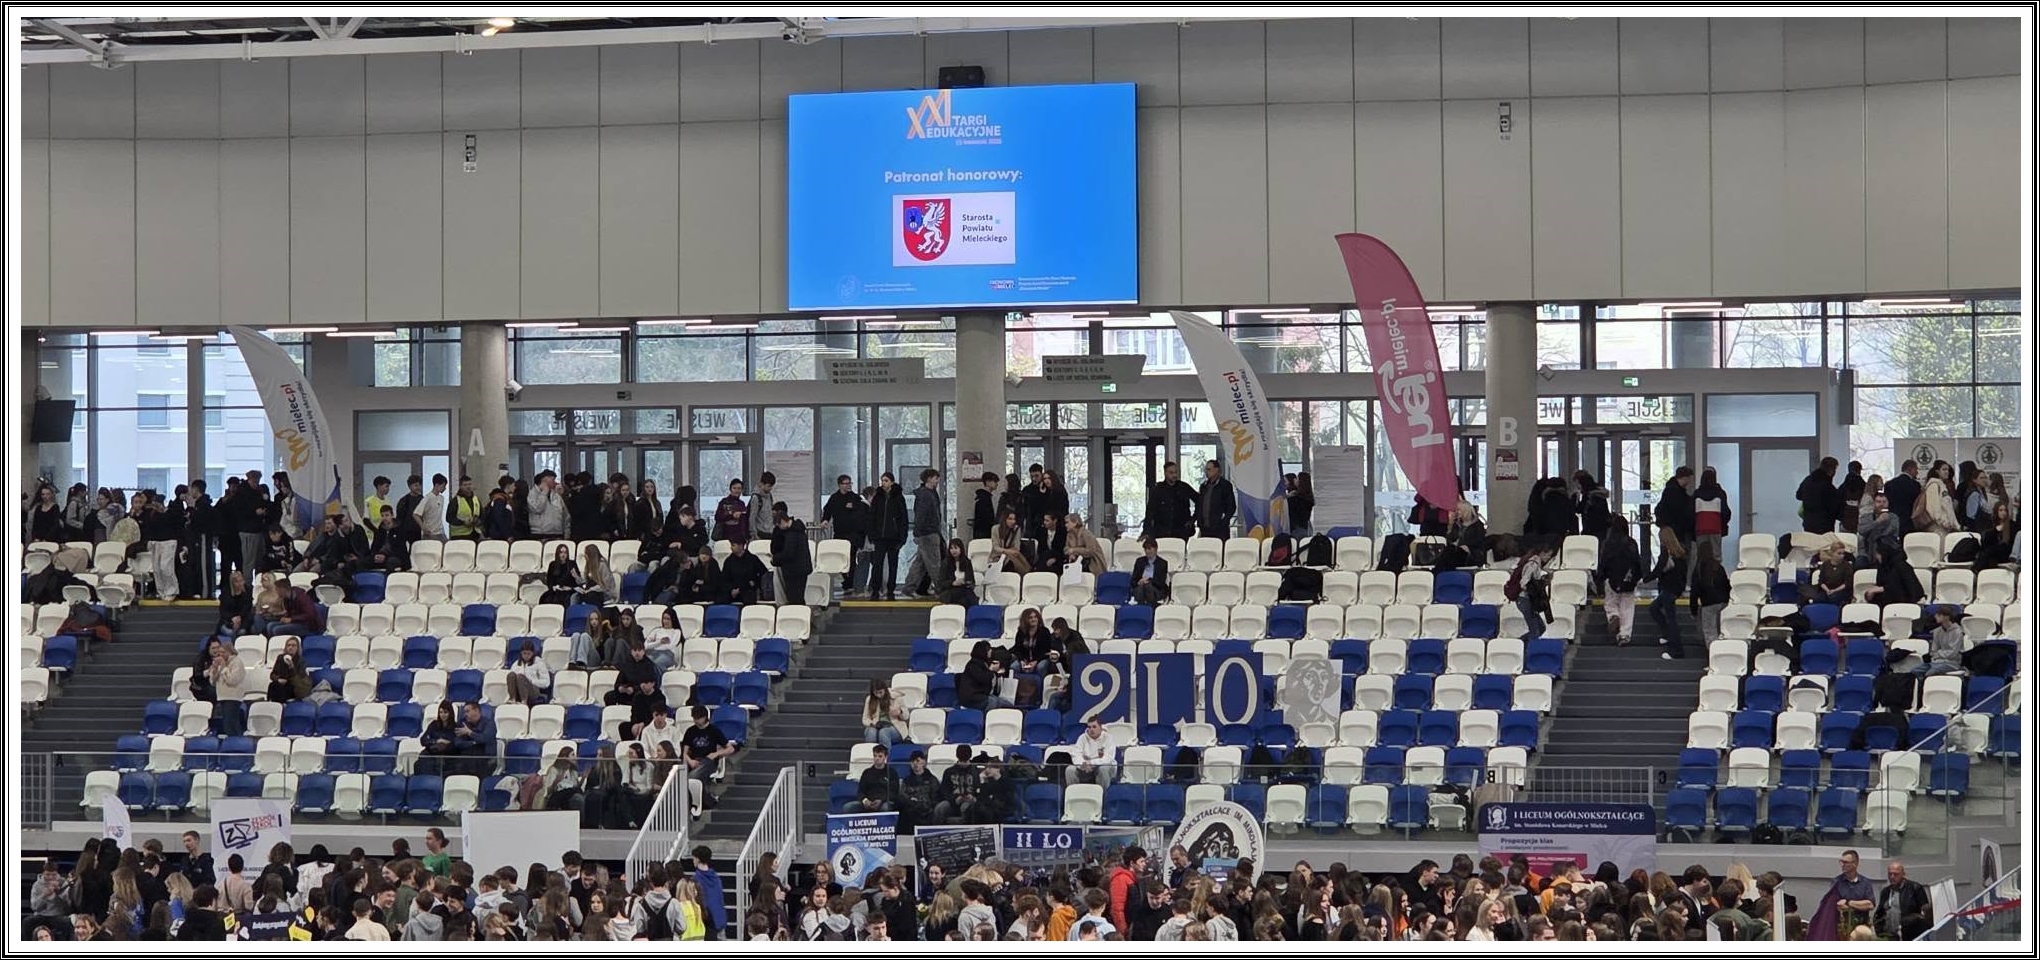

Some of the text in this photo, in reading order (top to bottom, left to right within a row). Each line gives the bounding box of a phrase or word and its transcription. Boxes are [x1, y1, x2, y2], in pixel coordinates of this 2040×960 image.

[907, 89, 951, 139] XXI
[952, 114, 987, 126] TARGI
[926, 125, 1001, 138] EDUKACYJNE
[885, 168, 1023, 183] Patronat honorowy:
[962, 213, 994, 222] Starosta
[962, 224, 993, 233] Powiatu
[962, 234, 1008, 243] Mieleckiego
[1222, 371, 1250, 425] mielec.pl
[280, 383, 307, 433] mielec.pl
[1499, 417, 1518, 446] B
[468, 428, 486, 456] A
[1513, 811, 1517, 819] I
[1519, 811, 1552, 819] LICEUM
[854, 818, 878, 827] LICEUM
[1016, 832, 1072, 849] II LO
